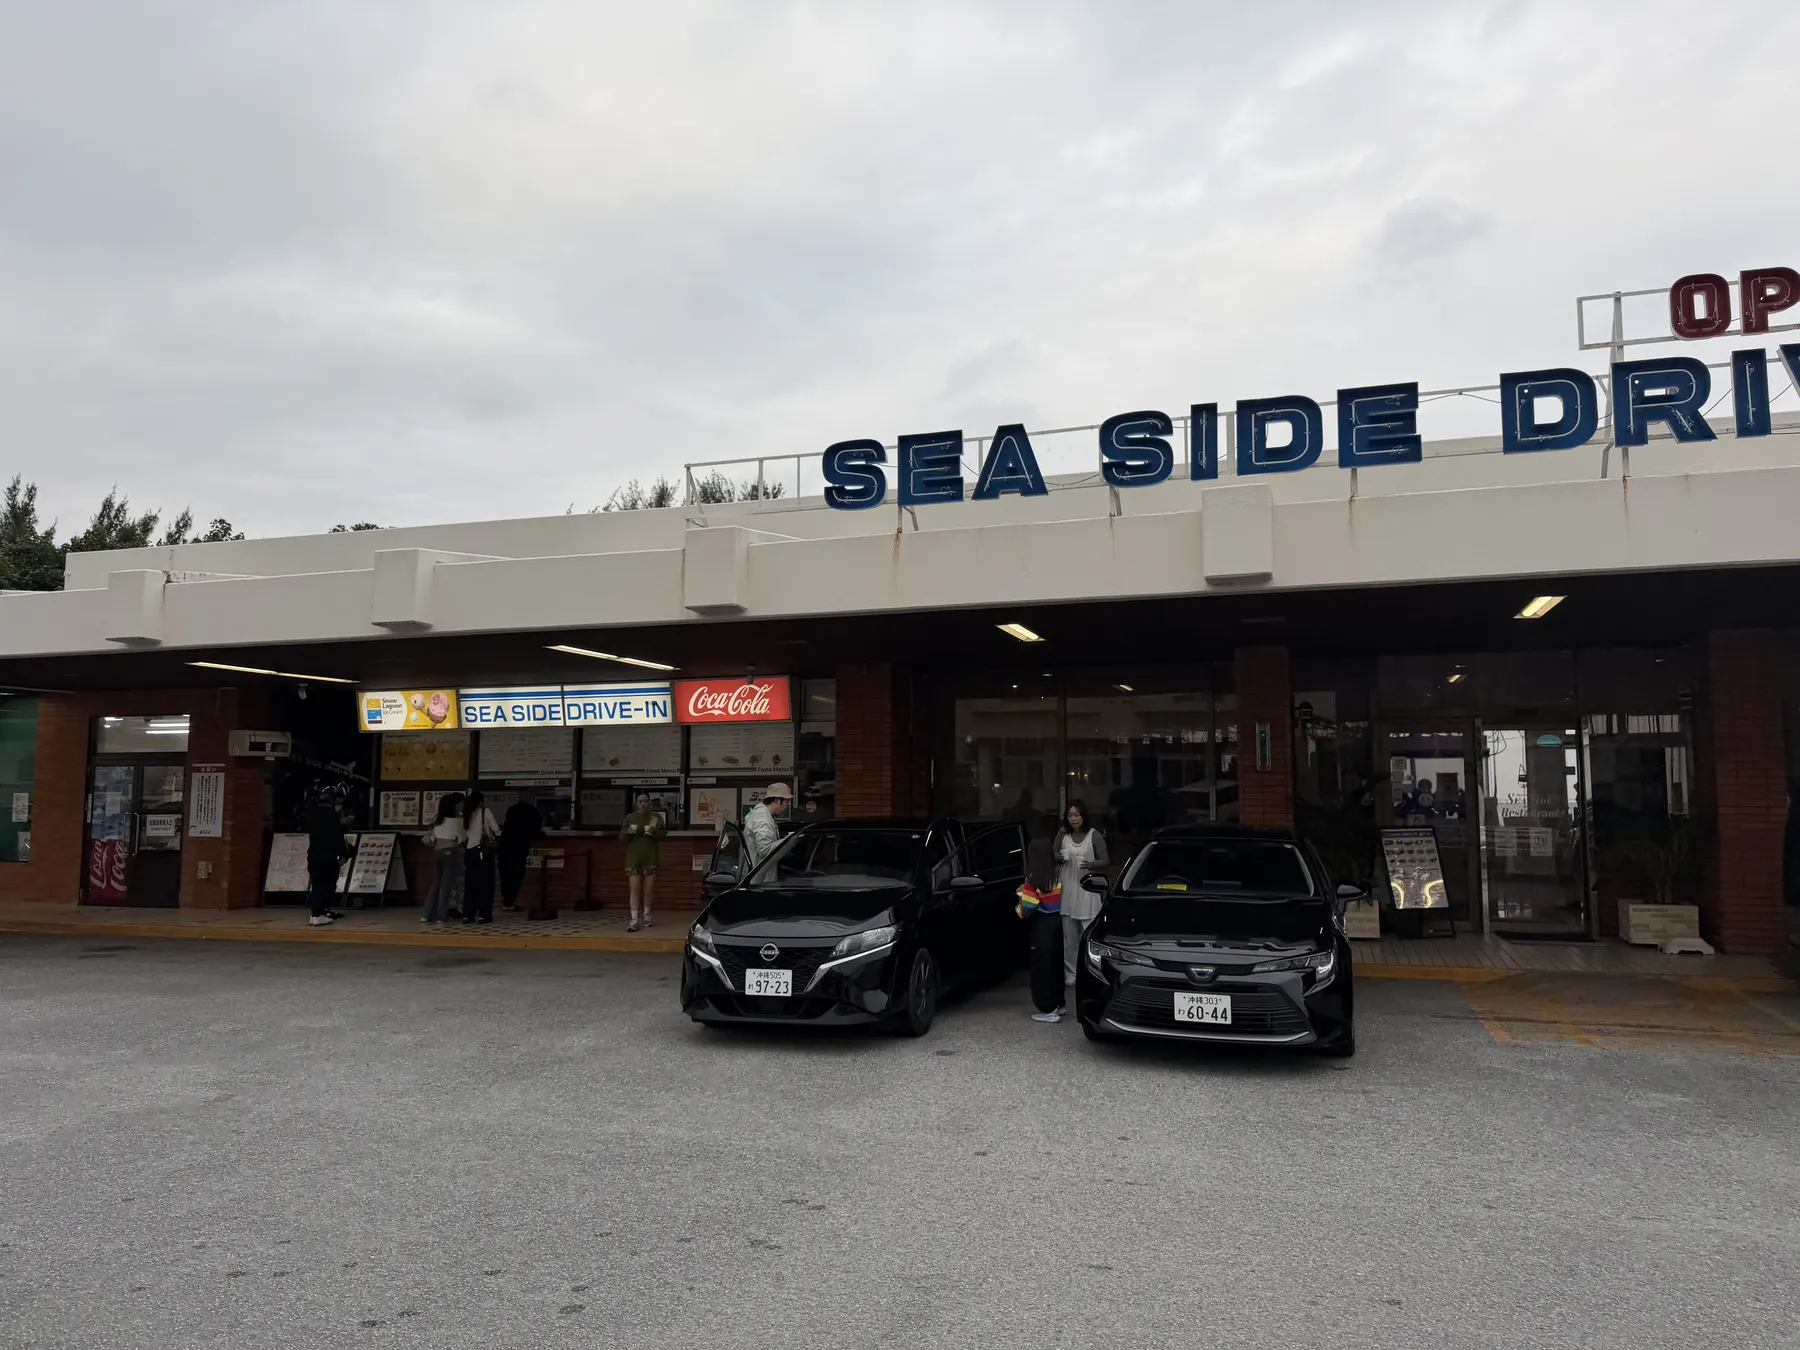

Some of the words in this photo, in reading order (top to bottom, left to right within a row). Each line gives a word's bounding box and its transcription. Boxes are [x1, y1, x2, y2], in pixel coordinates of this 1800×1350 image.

[821, 423, 1049, 511] SEA
[1099, 381, 1423, 487] SIDE
[1500, 343, 1800, 454] DRI
[465, 705, 508, 724] SEA
[512, 703, 562, 722] SIDE
[567, 699, 667, 721] DRIVE-IN
[688, 683, 775, 717] Coca-Cola
[756, 980, 789, 994] 97-23
[1188, 1006, 1228, 1021] 60-44
